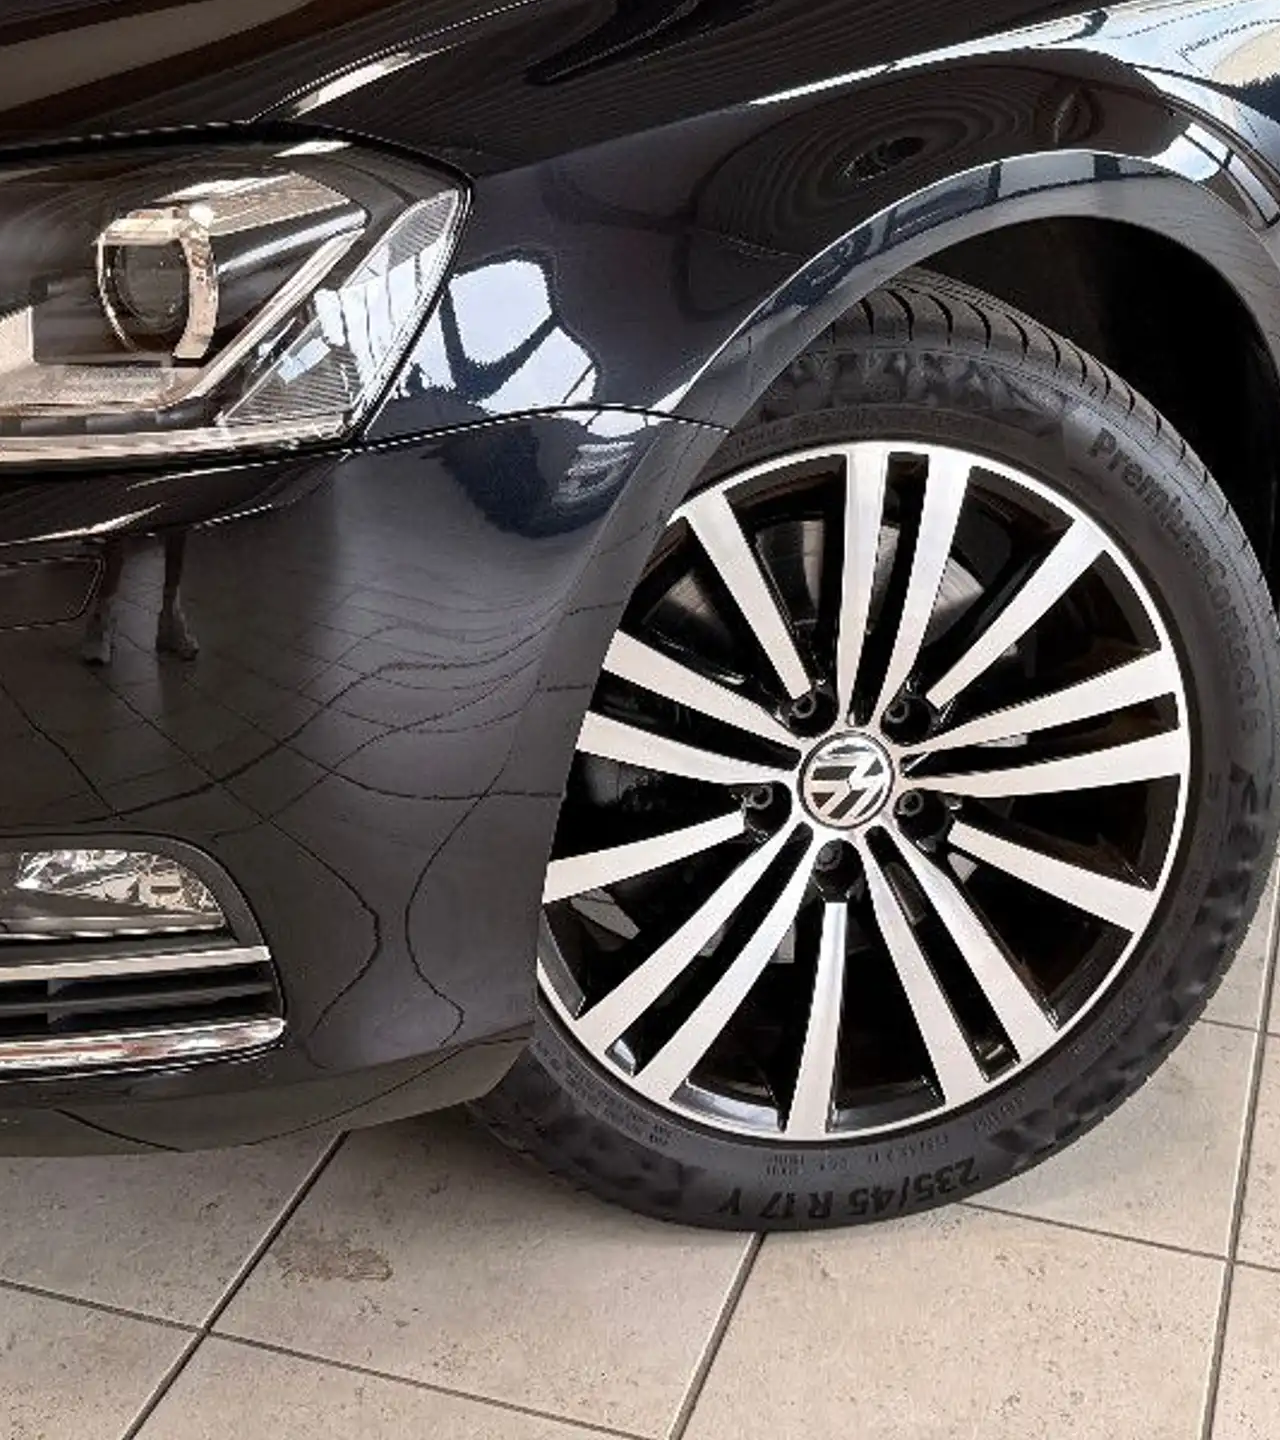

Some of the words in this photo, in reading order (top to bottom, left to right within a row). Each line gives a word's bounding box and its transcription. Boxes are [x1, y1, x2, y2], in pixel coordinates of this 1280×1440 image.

[849, 1157, 981, 1208] 235/45
[759, 1191, 797, 1220] 17
[808, 1190, 834, 1219] R
